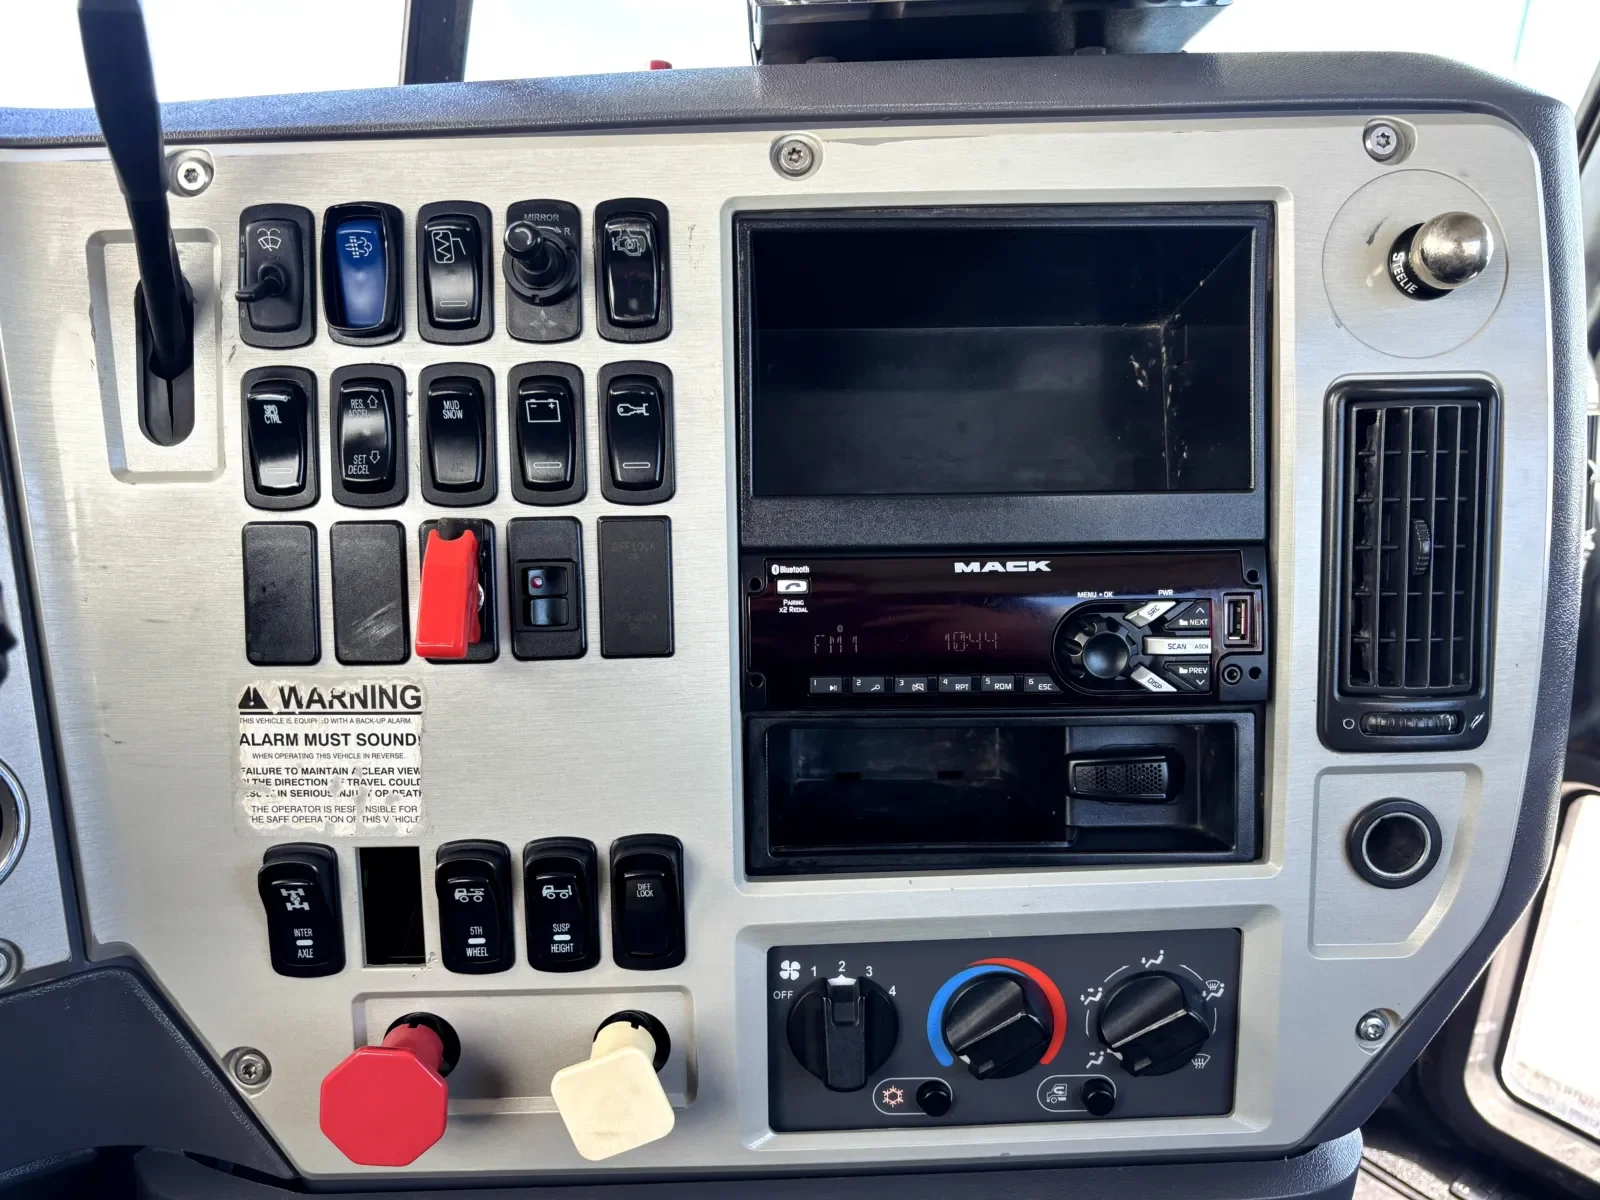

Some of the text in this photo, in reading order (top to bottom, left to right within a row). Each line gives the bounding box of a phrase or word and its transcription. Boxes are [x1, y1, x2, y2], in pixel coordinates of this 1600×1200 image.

[524, 214, 560, 222] MIRROR
[564, 228, 571, 236] R
[1392, 252, 1418, 294] STEELIE
[350, 399, 366, 409] RES.
[443, 400, 460, 410] MUD
[264, 404, 278, 415] SPD
[264, 414, 282, 424] CTRL
[442, 410, 463, 420] SNOW
[353, 454, 367, 464] SET
[348, 464, 370, 474] DECEL
[780, 565, 810, 574] Bluetooth
[954, 560, 1052, 573] MACK
[1148, 604, 1160, 618] SRC
[945, 632, 998, 652] 10:44
[1167, 642, 1187, 650] SCAN
[1147, 678, 1162, 690] DISP
[278, 684, 422, 710] WARNING
[240, 733, 298, 746] ALARM
[304, 733, 352, 746] MUST
[638, 883, 651, 891] DIFF
[636, 890, 654, 898] LOCK
[470, 926, 483, 936] 5TH
[552, 923, 570, 932] SUSP
[294, 928, 312, 938] INTER
[298, 948, 314, 958] AXLE
[466, 946, 488, 957] WHEEL
[550, 943, 574, 954] HEIGHT
[838, 960, 846, 972] 2
[810, 966, 817, 977] 1
[866, 966, 873, 977] 3
[772, 990, 794, 1000] OFF
[888, 985, 896, 996] 4
